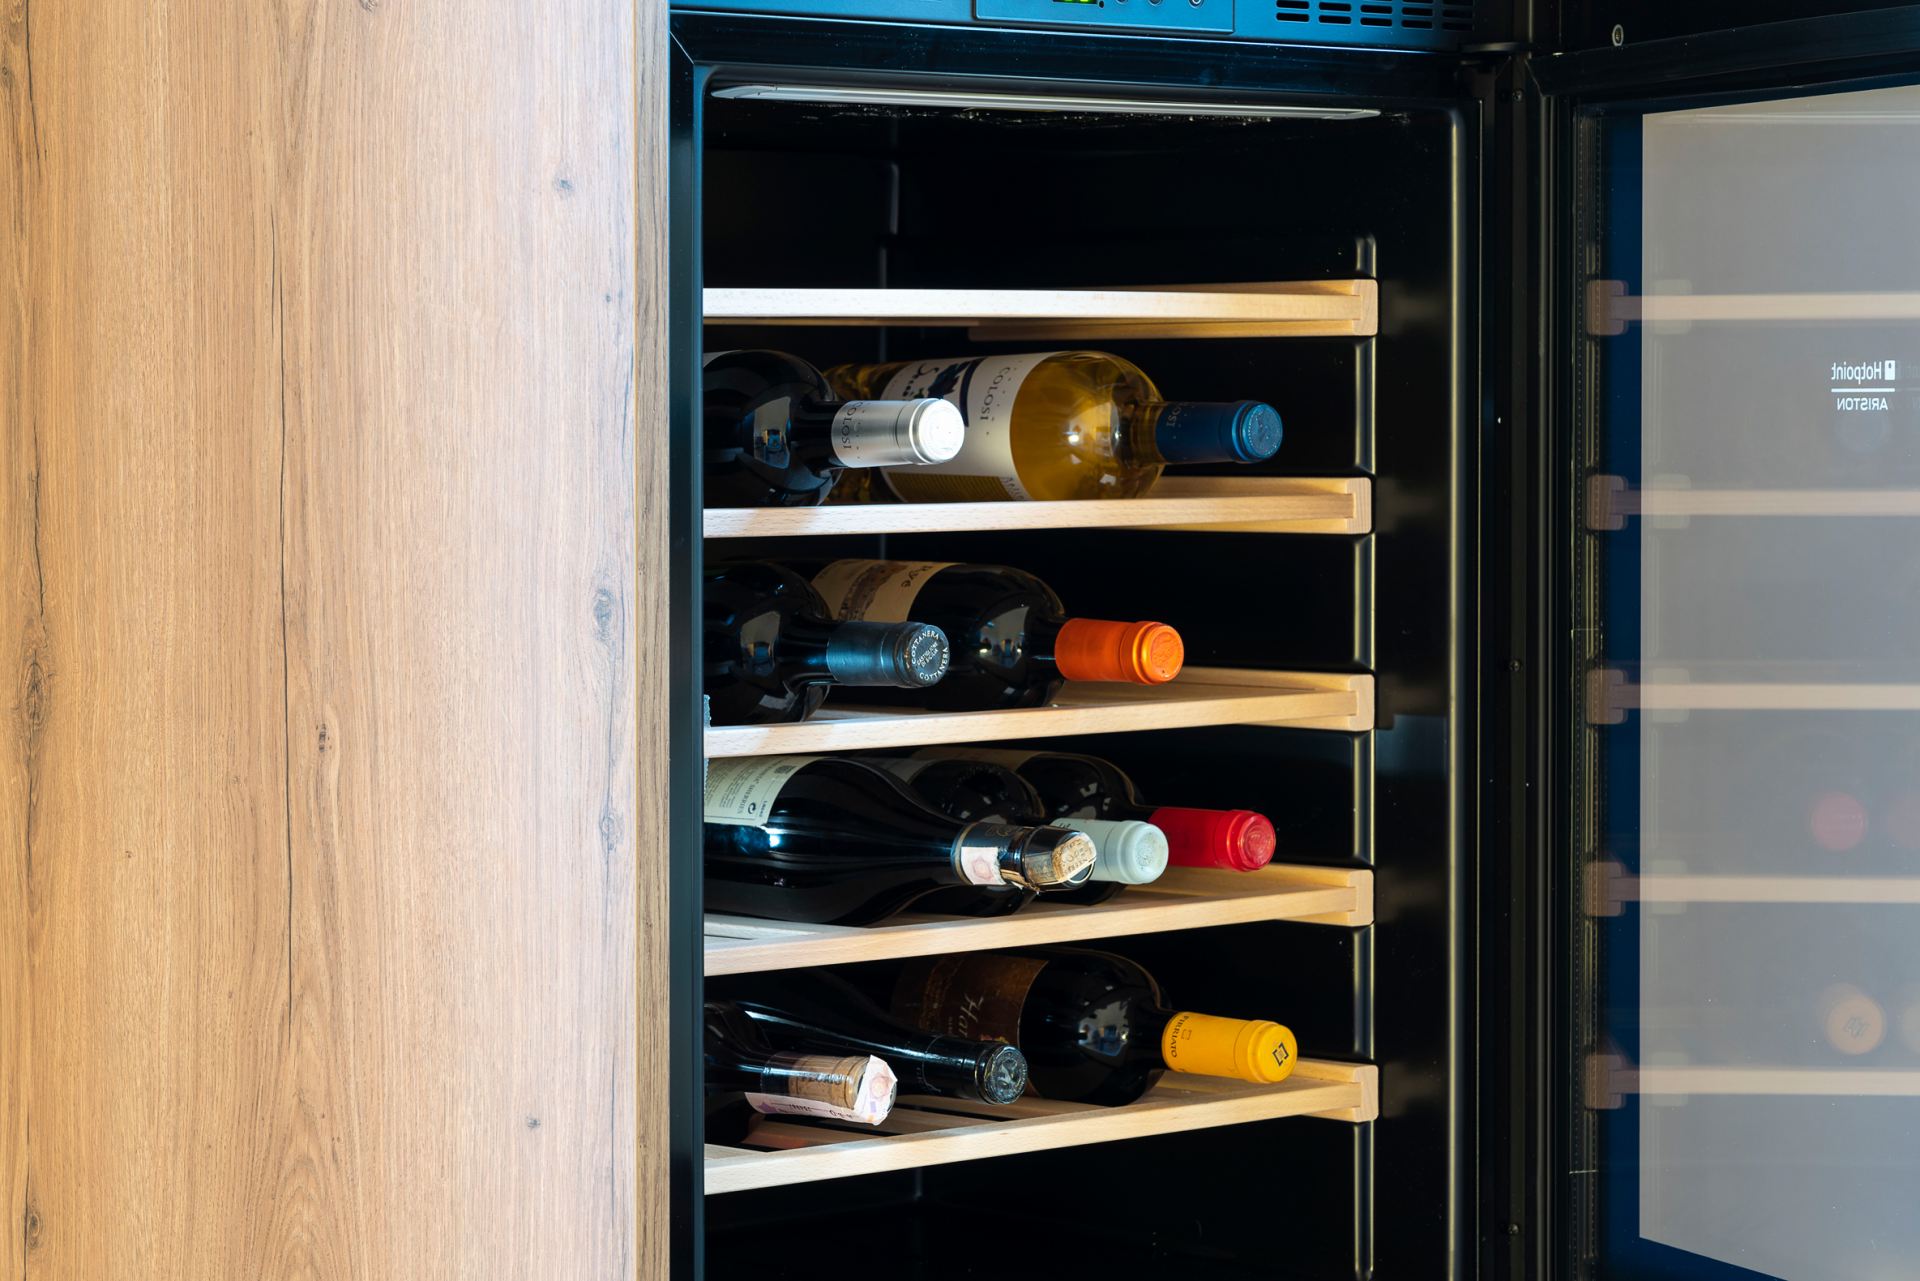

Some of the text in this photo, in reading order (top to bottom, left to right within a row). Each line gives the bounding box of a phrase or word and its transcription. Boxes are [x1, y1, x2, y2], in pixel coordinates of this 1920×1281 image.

[980, 366, 1010, 421] COLOSI
[841, 401, 864, 449] COLOSI
[911, 629, 939, 665] COTTANERA
[919, 646, 949, 681] COTTANERA
